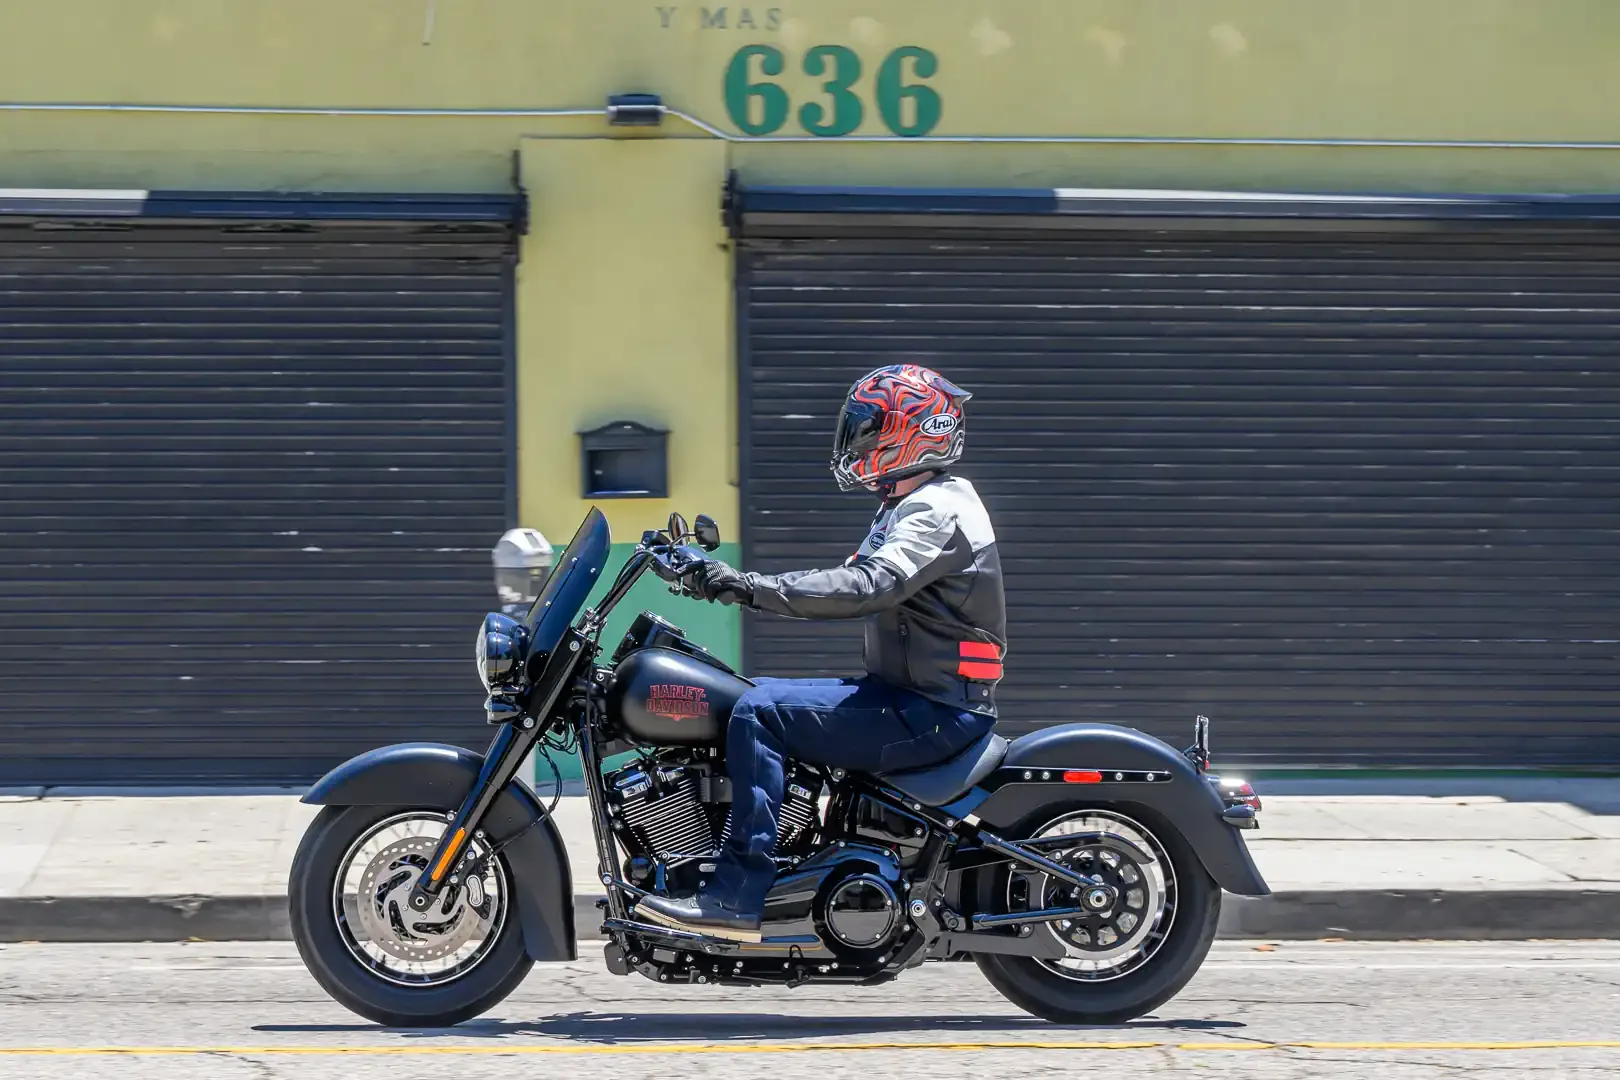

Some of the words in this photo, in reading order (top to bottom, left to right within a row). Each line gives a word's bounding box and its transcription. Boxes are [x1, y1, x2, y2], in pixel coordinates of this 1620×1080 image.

[654, 6, 678, 28] Y
[700, 6, 782, 31] MAS
[723, 44, 942, 137] 636
[926, 417, 953, 431] Arai
[646, 698, 709, 716] DAVIDSON
